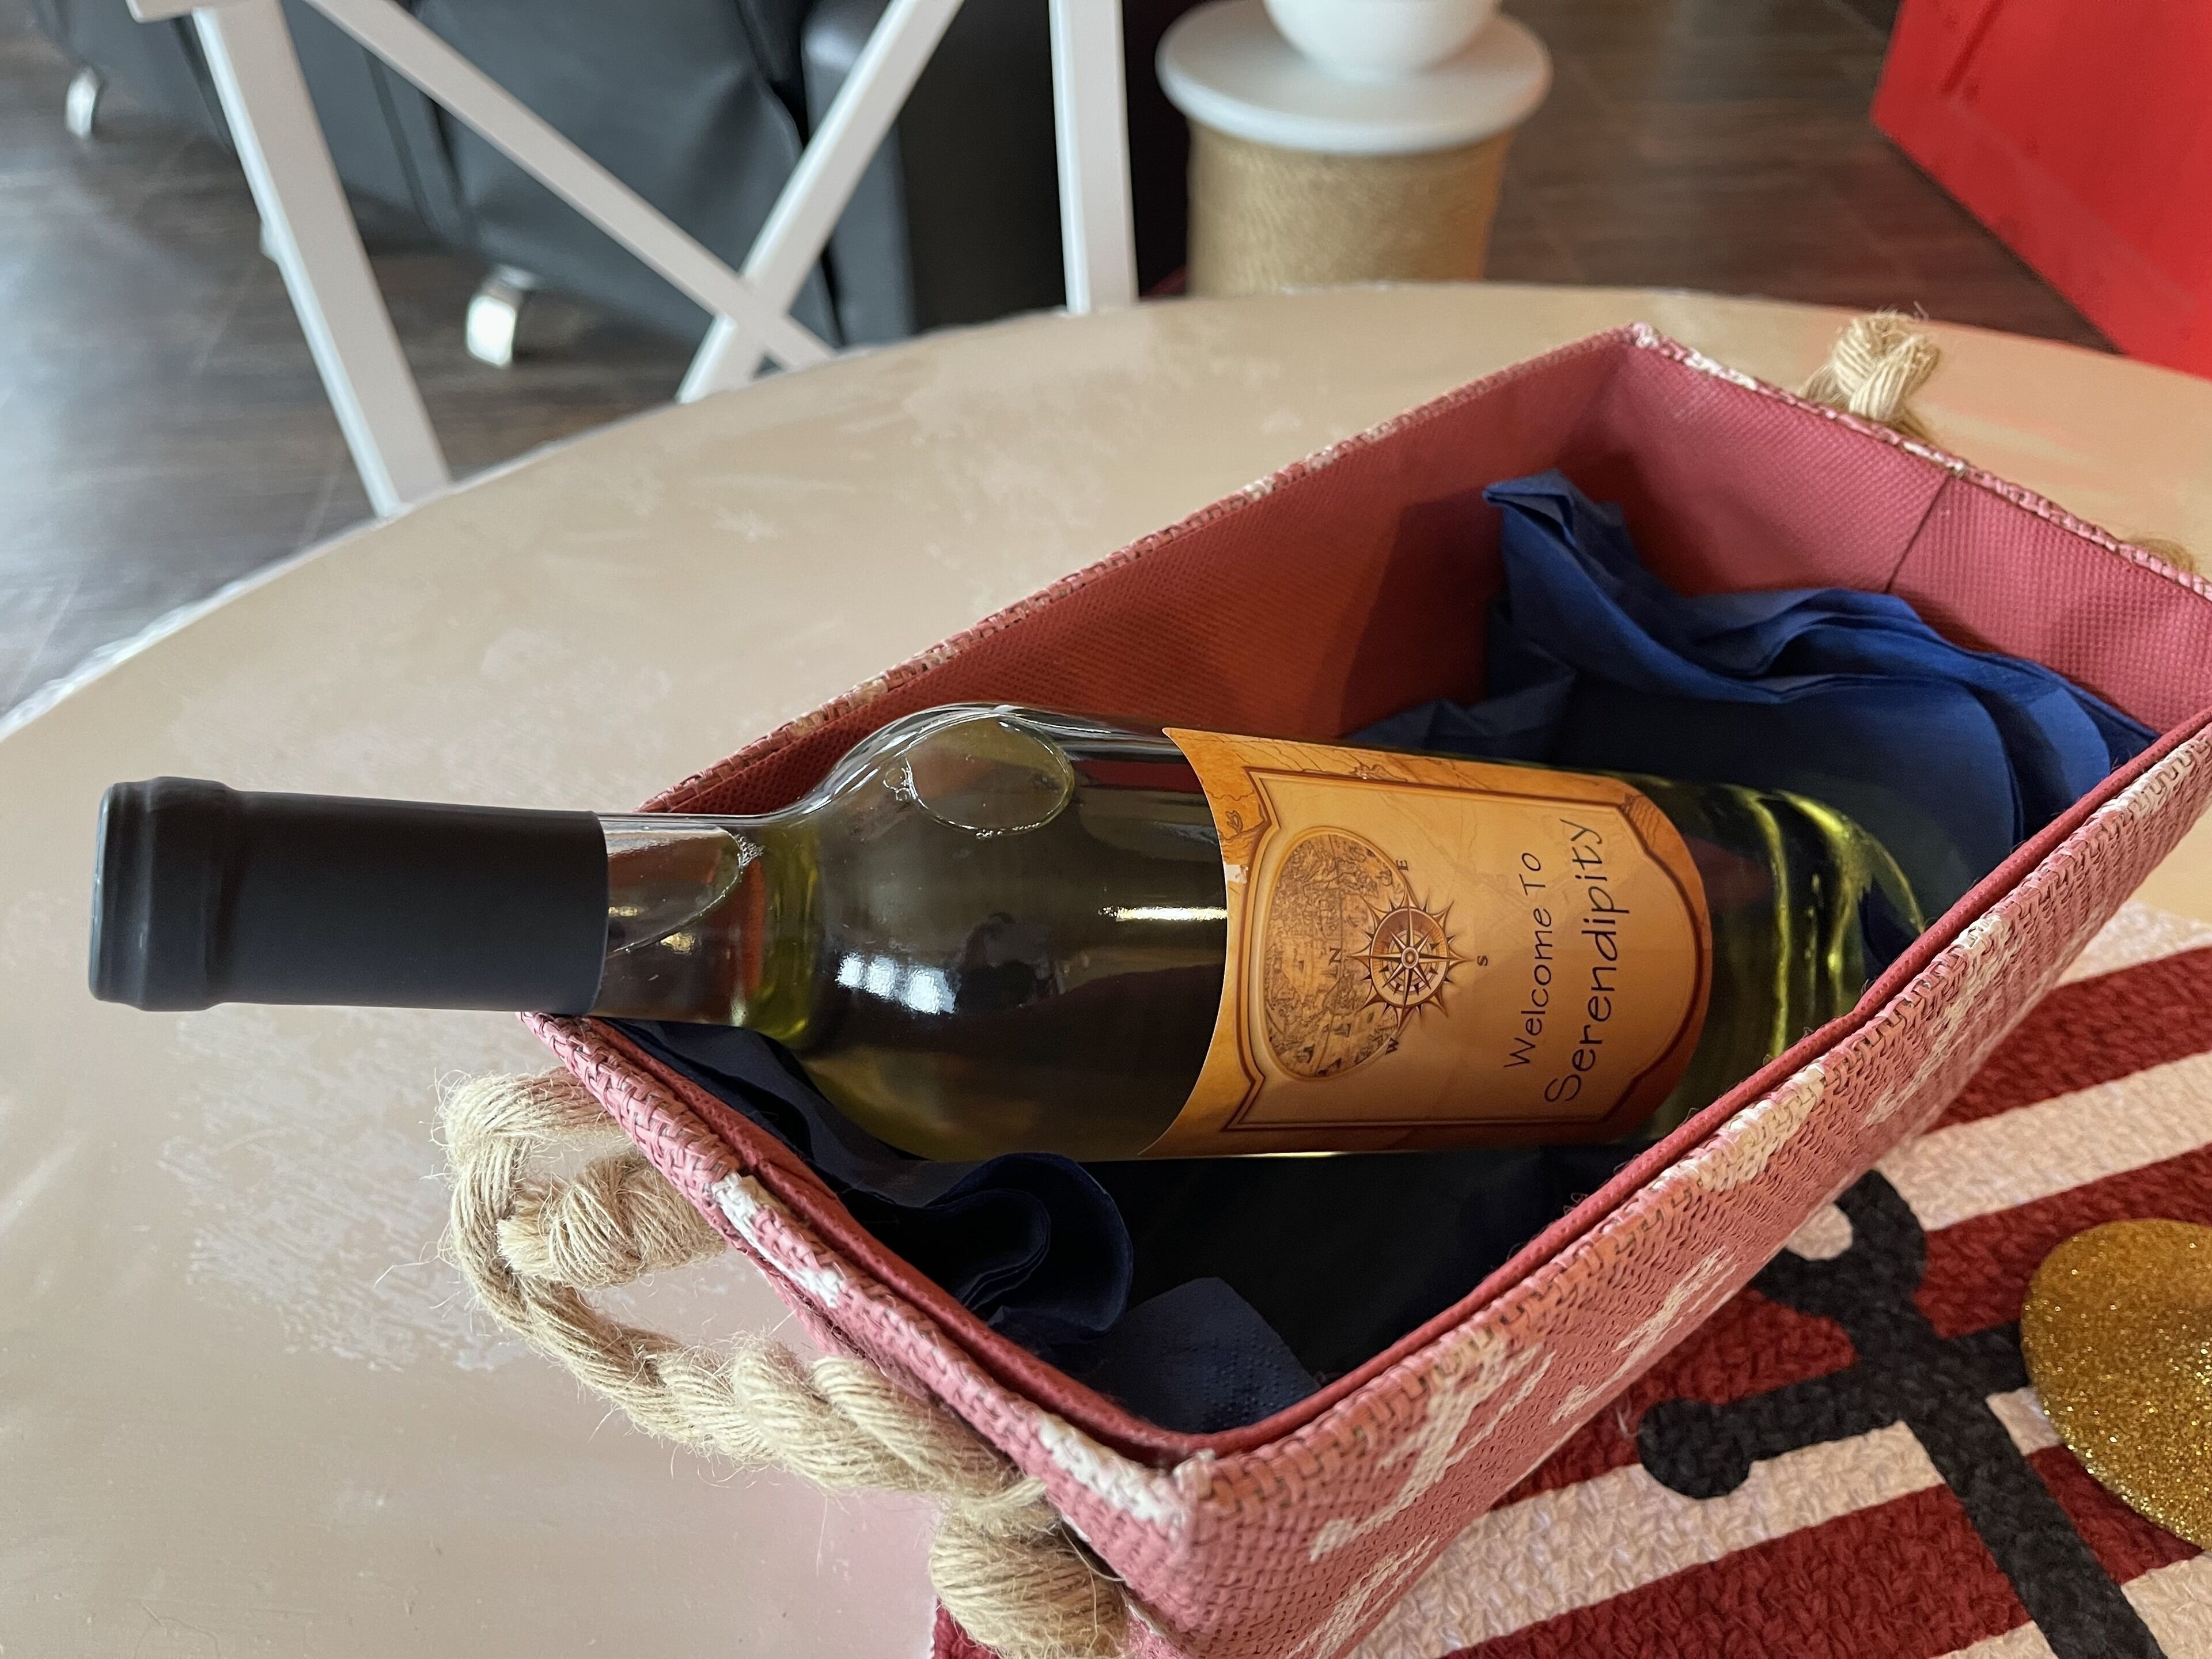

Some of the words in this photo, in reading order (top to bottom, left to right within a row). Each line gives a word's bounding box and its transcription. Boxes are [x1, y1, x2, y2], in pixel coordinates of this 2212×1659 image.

[1395, 859, 1409, 871] E
[1518, 853, 1546, 896] To
[1329, 947, 1341, 965] N
[1477, 955, 1488, 967] S
[1544, 817, 1630, 1103] Serendipity
[1503, 908, 1553, 1068] Welcome
[1385, 1037, 1400, 1054] W
